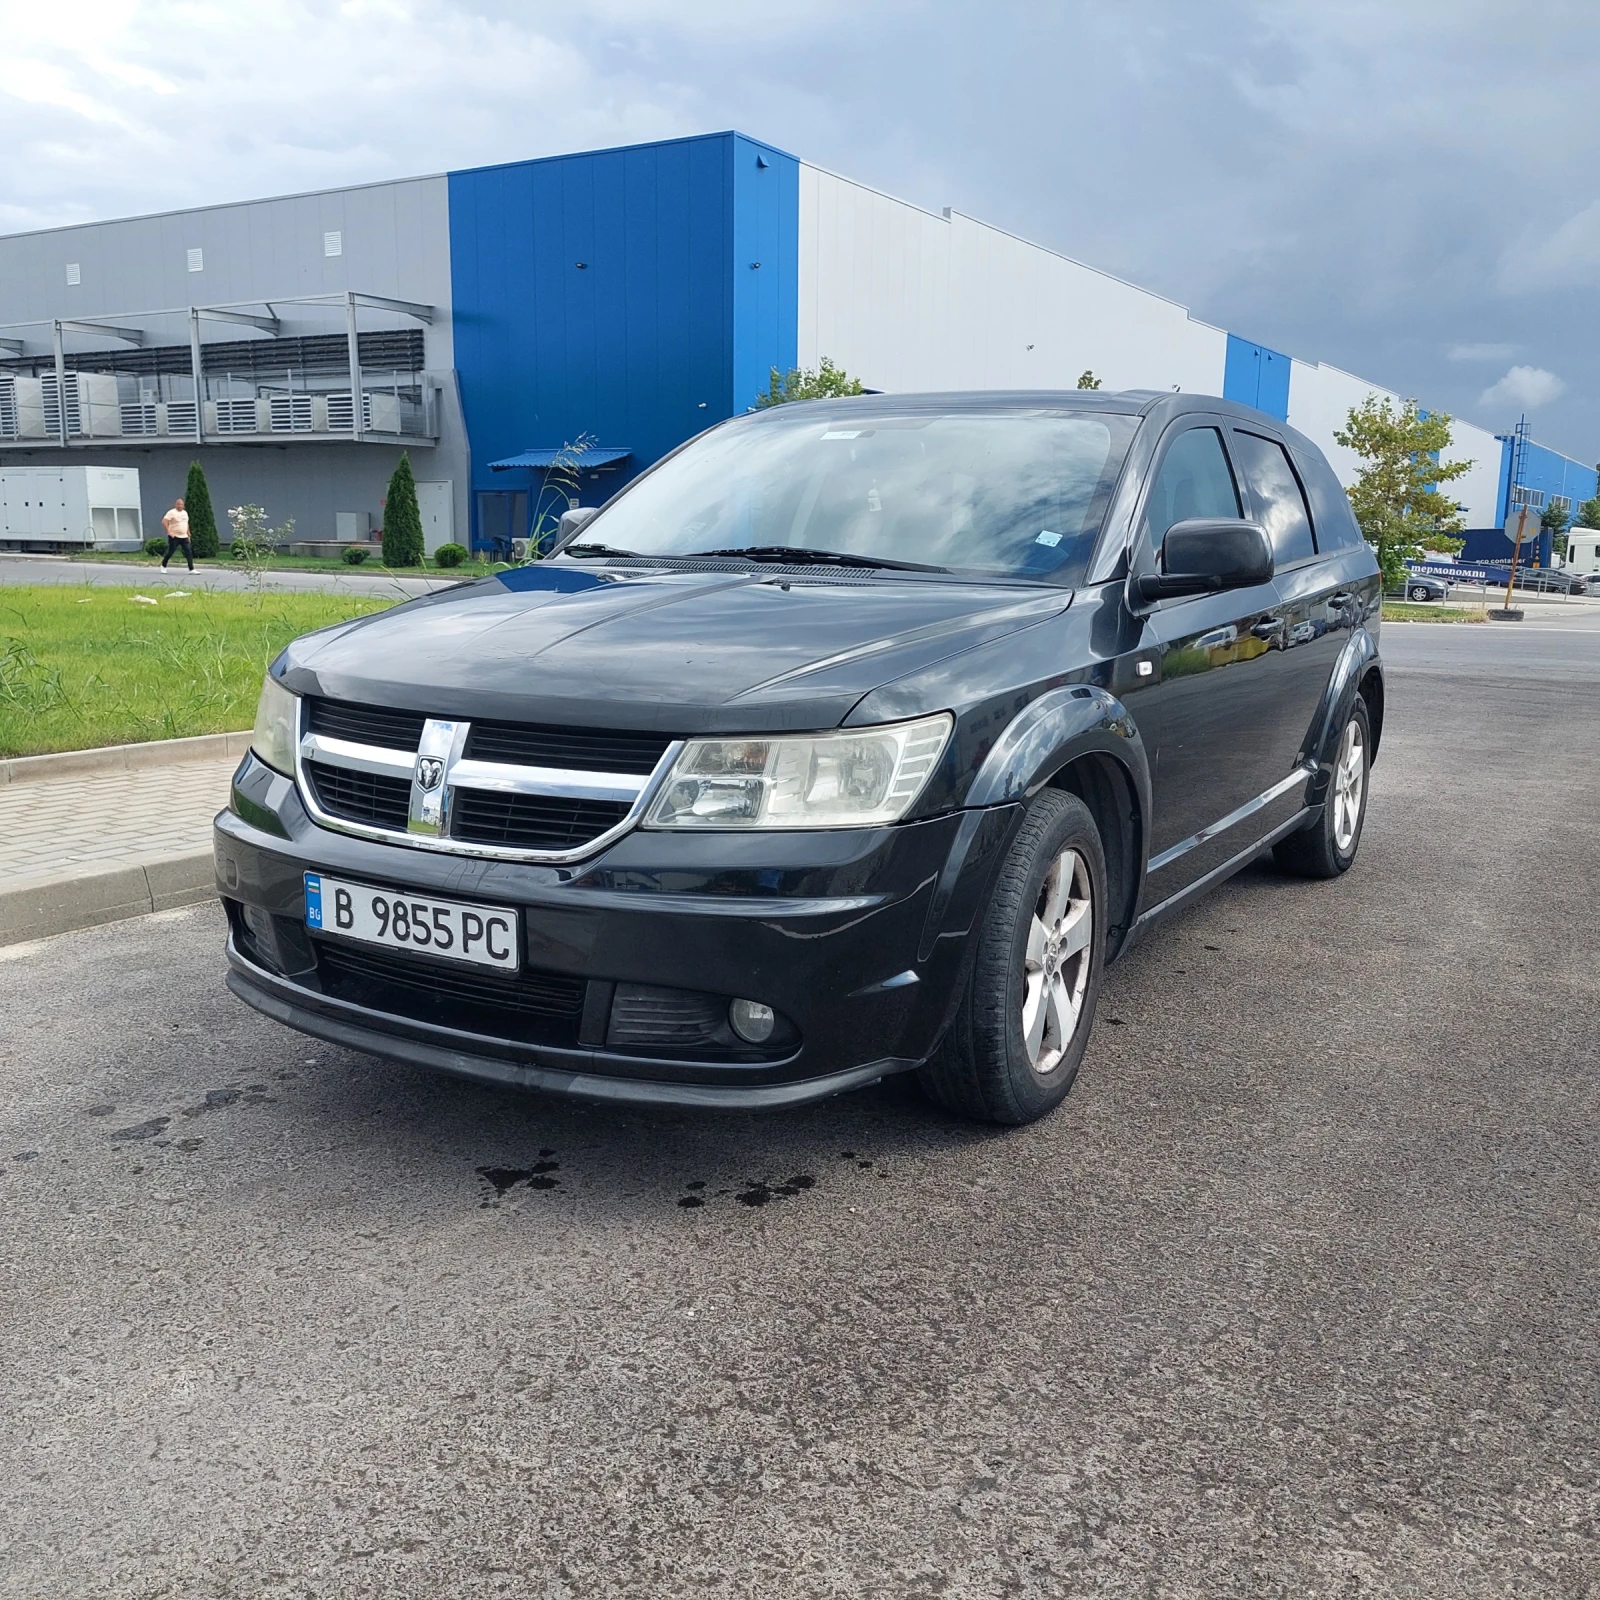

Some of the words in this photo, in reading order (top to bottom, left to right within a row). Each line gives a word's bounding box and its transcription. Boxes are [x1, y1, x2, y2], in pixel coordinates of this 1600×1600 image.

[1411, 565, 1486, 578] термопомпи
[309, 906, 321, 921] BG
[335, 887, 354, 930] B
[371, 896, 454, 950] 9855
[461, 911, 510, 961] PC
